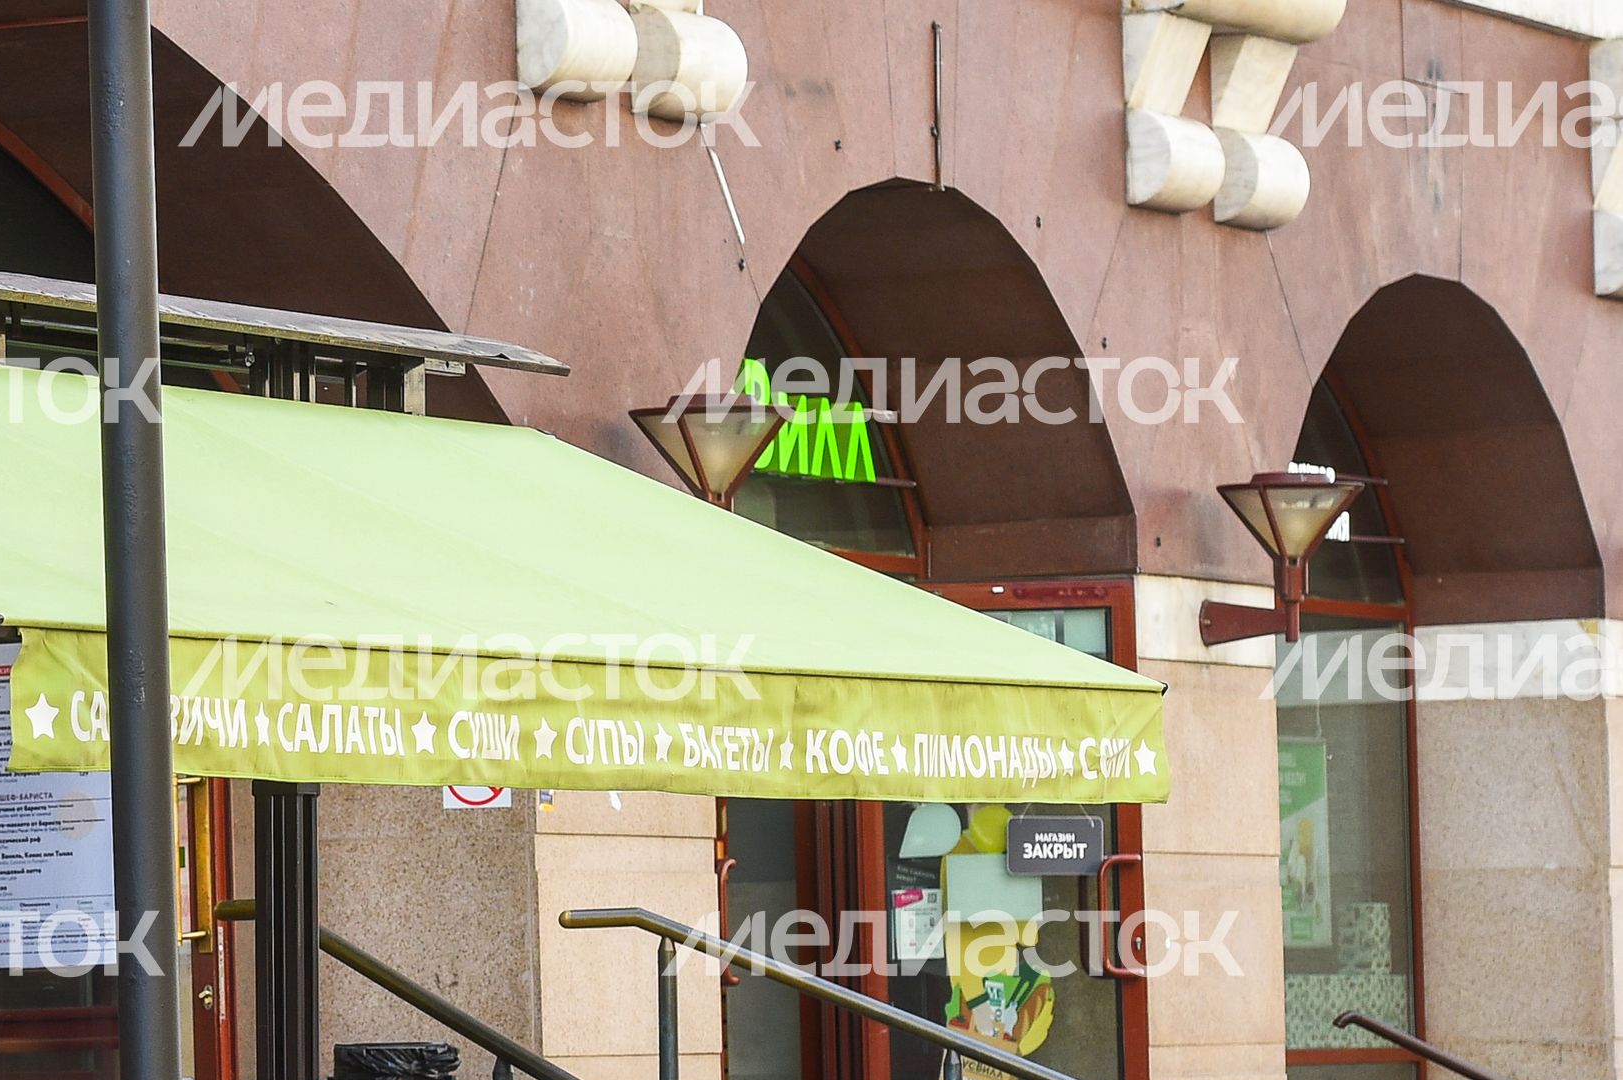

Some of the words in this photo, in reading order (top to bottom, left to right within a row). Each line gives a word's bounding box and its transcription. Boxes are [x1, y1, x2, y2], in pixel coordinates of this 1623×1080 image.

[71, 690, 248, 748] САВИЧИ
[277, 703, 405, 757] САЛАТЫ
[448, 710, 520, 761] СУШИ
[565, 716, 645, 766] СУПЫ
[679, 722, 773, 772] БАГЕТЫ
[805, 728, 890, 777] КОФЕ
[913, 733, 1058, 788] ЛИМОНАДЫ
[1035, 833, 1075, 843] МАГАЗИН
[1023, 843, 1088, 860] ЗАКРЫТ
[963, 1058, 1004, 1080] УСВИЛЛ
